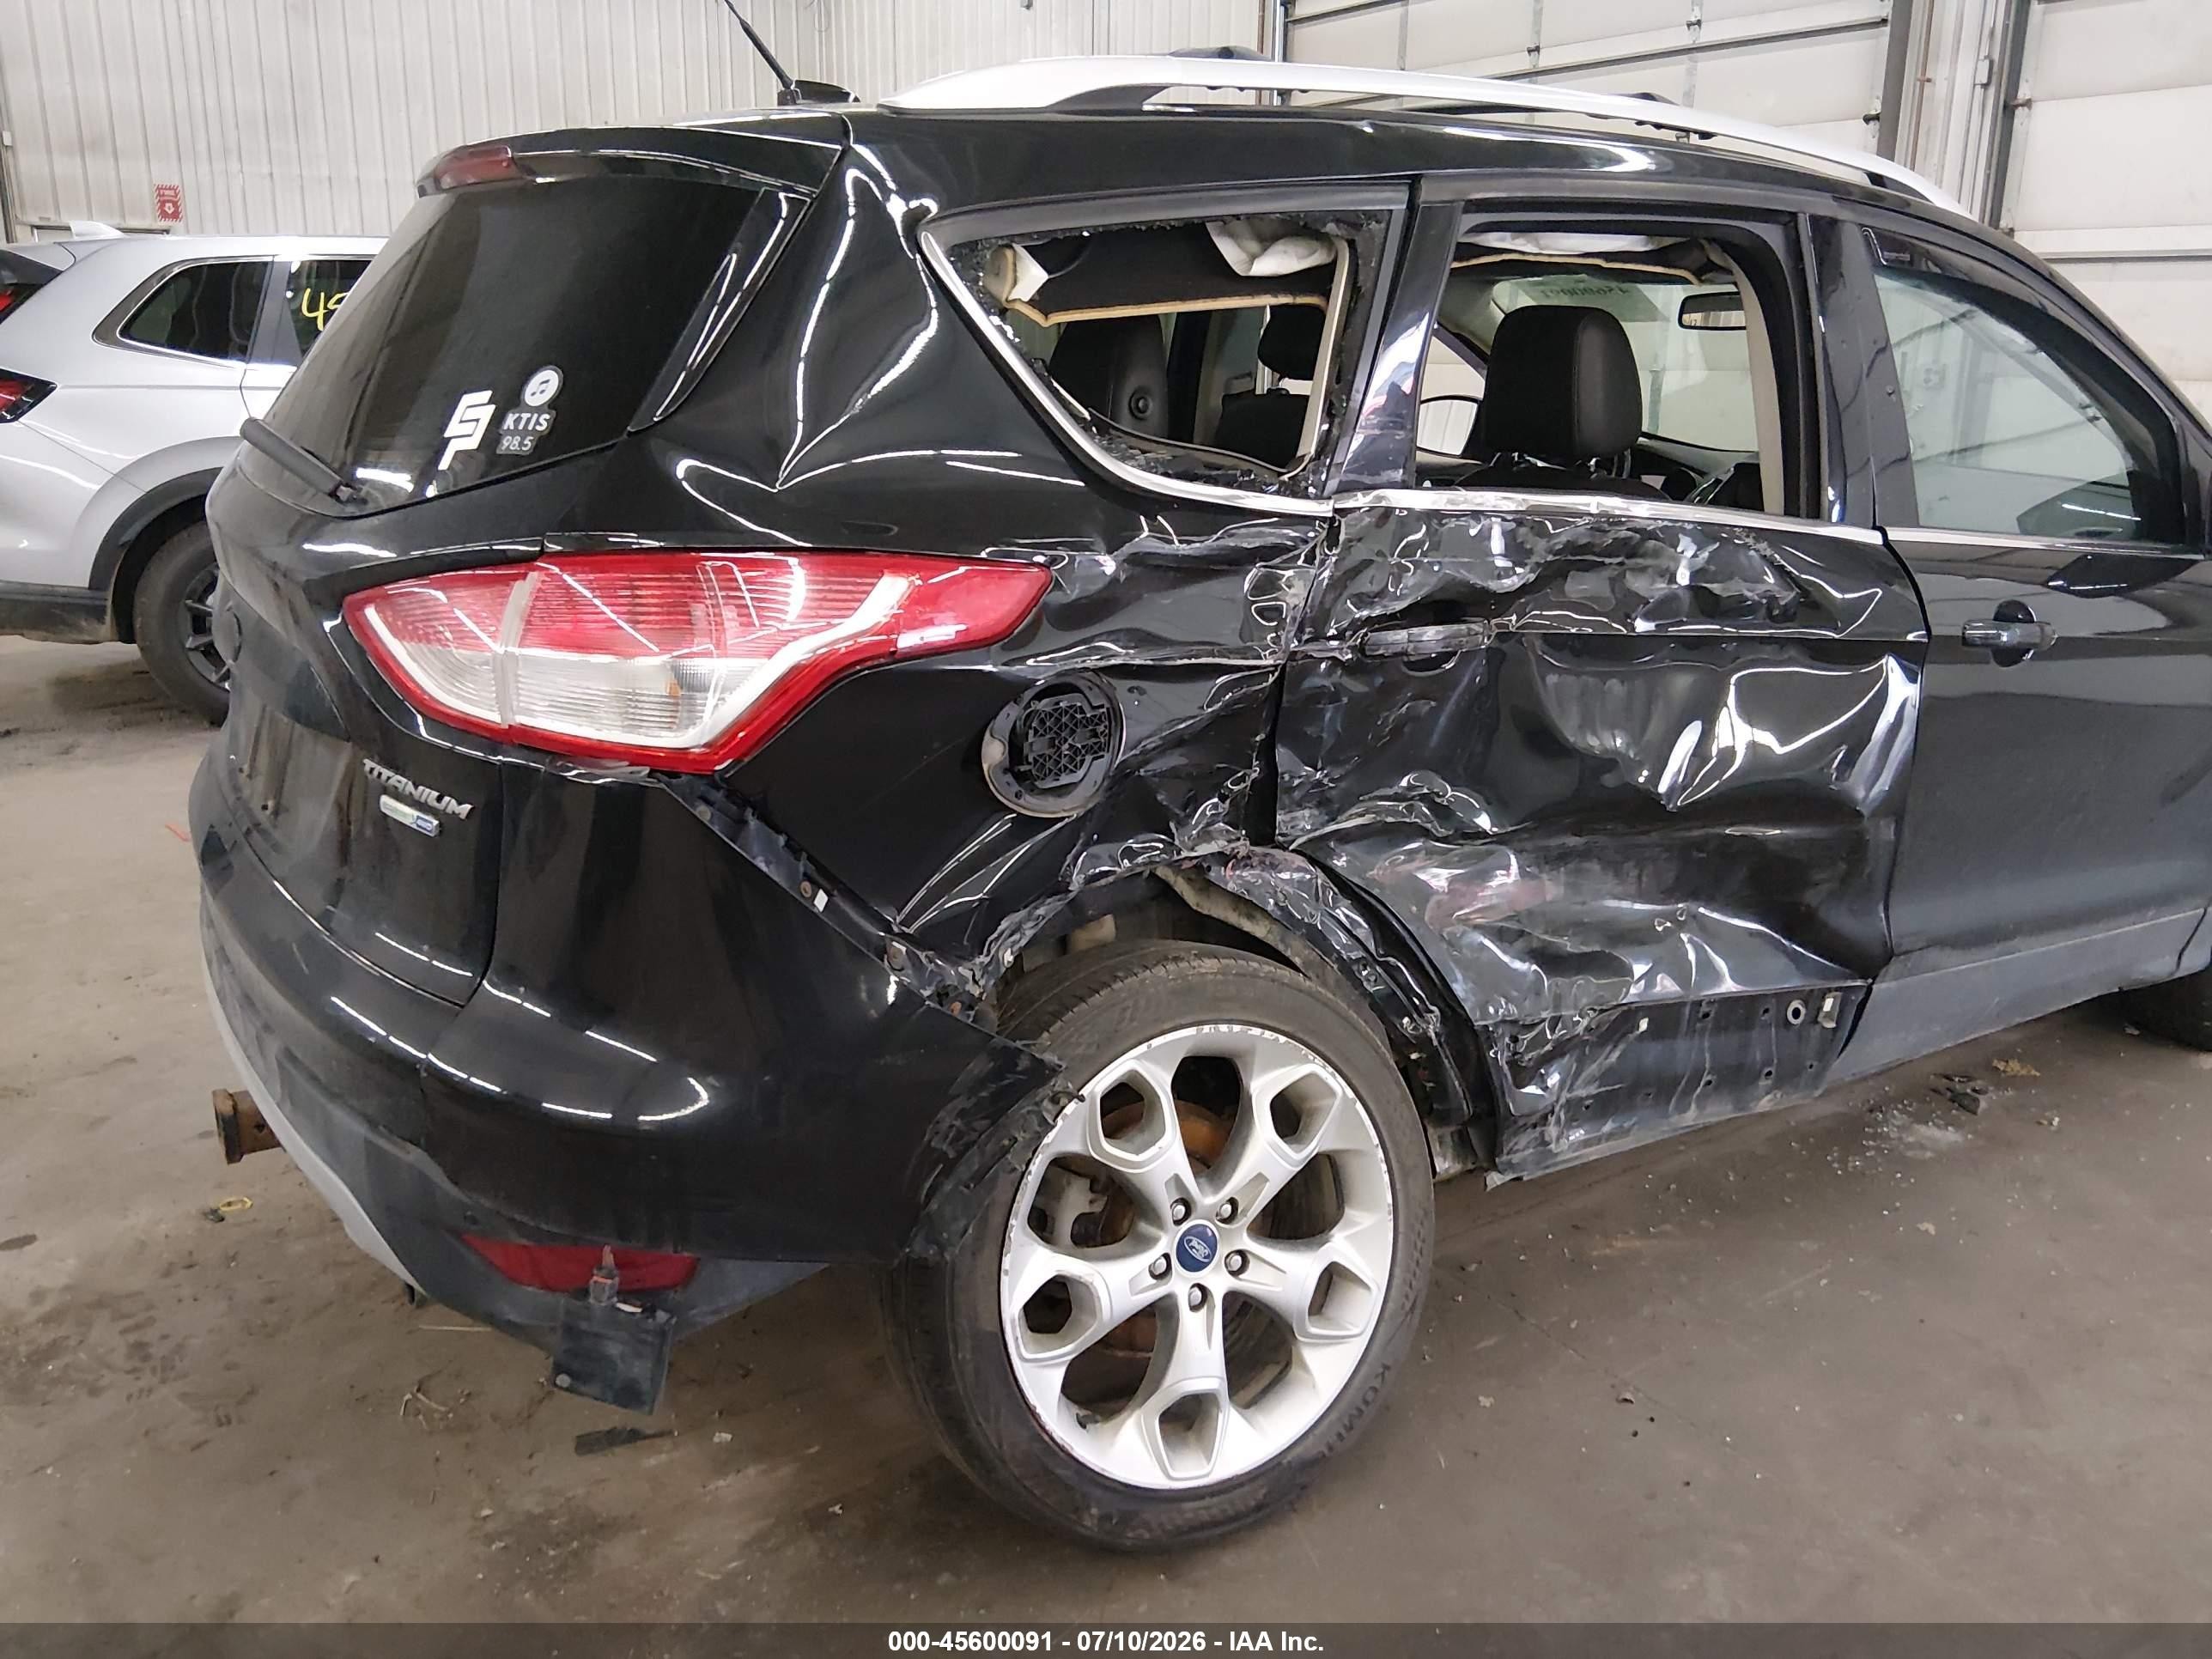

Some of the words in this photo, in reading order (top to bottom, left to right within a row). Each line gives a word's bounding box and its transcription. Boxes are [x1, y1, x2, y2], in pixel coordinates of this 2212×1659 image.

[503, 413, 550, 431] KTIS
[501, 435, 534, 451] 98.5
[362, 758, 474, 819] TITANIUM
